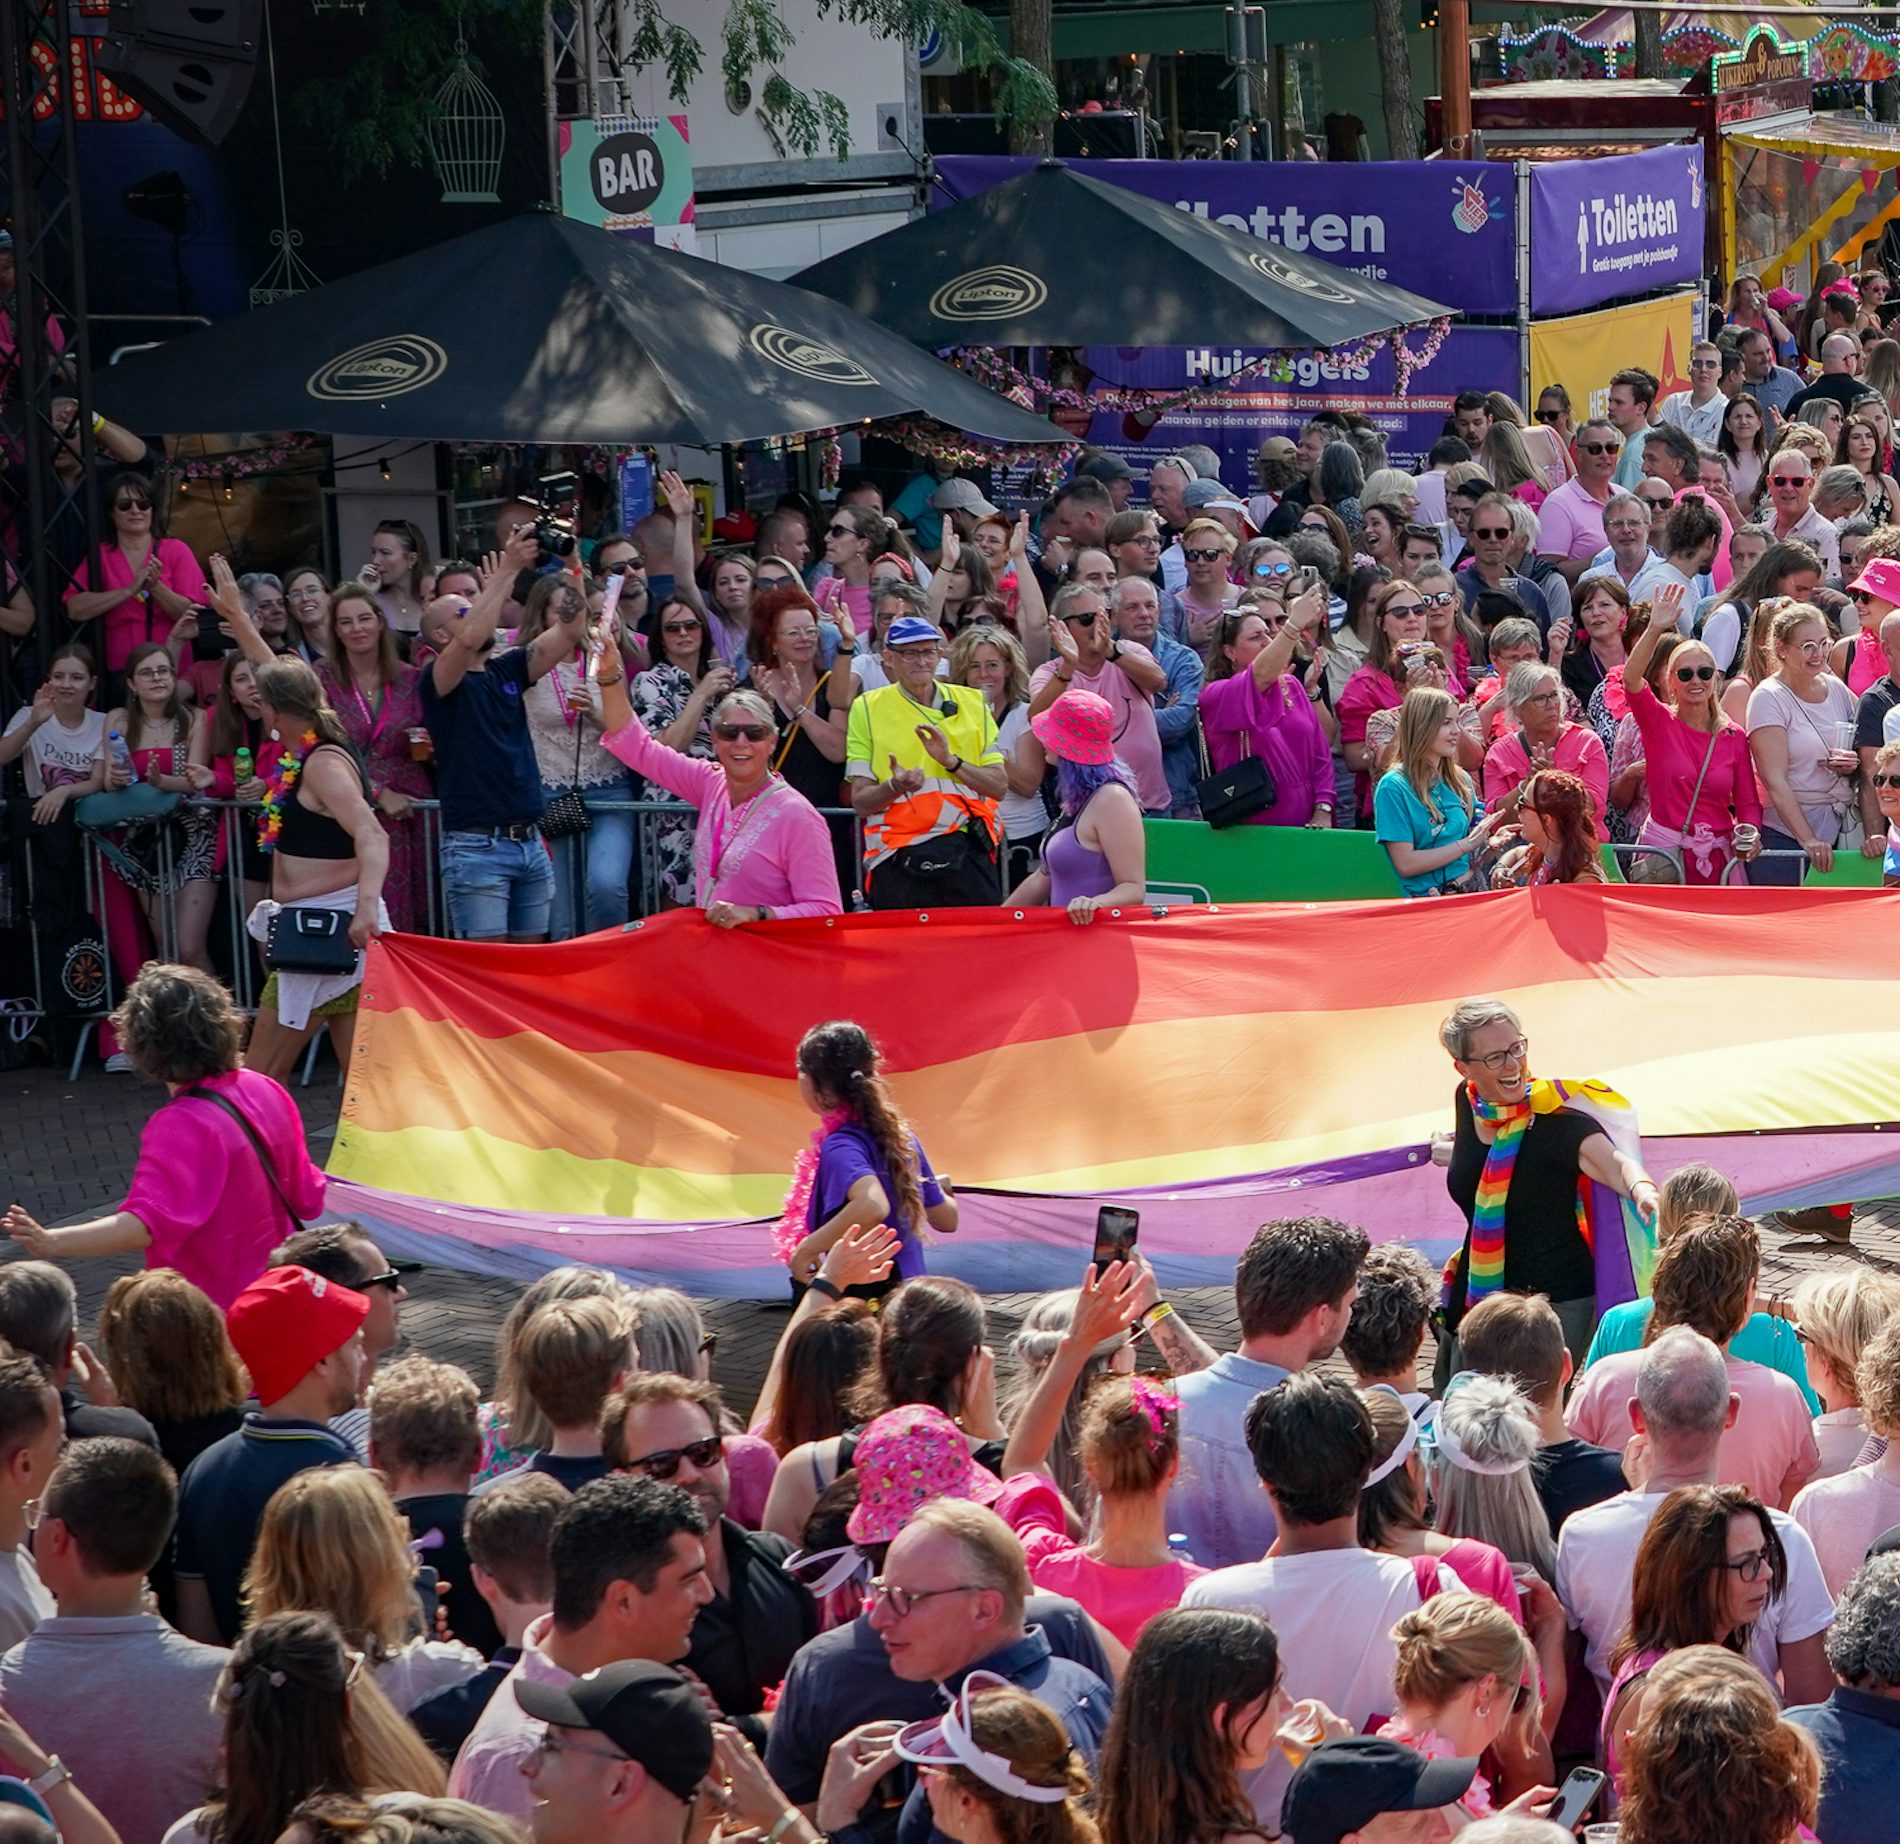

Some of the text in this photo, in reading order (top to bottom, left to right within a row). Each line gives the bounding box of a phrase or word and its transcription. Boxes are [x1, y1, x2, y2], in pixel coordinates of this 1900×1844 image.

[598, 149, 658, 198] BAR
[1591, 193, 1678, 247] Toiletten
[1592, 255, 1611, 272] Gratis
[1610, 254, 1634, 272] toegang
[1633, 250, 1643, 265] met
[959, 288, 1017, 300] Lipton
[344, 362, 408, 376] Lipton
[1210, 395, 1248, 409] dagen
[1249, 396, 1271, 406] van
[1272, 395, 1294, 406] het
[1293, 397, 1324, 411] jaar,
[1325, 398, 1366, 410] maken
[1367, 400, 1384, 410] we
[1385, 399, 1410, 410] met
[1411, 398, 1452, 411] elkaar.
[1204, 414, 1245, 428] gelden
[1246, 416, 1260, 426] er
[1260, 415, 1301, 427] enkele
[44, 743, 93, 765] PARIS
